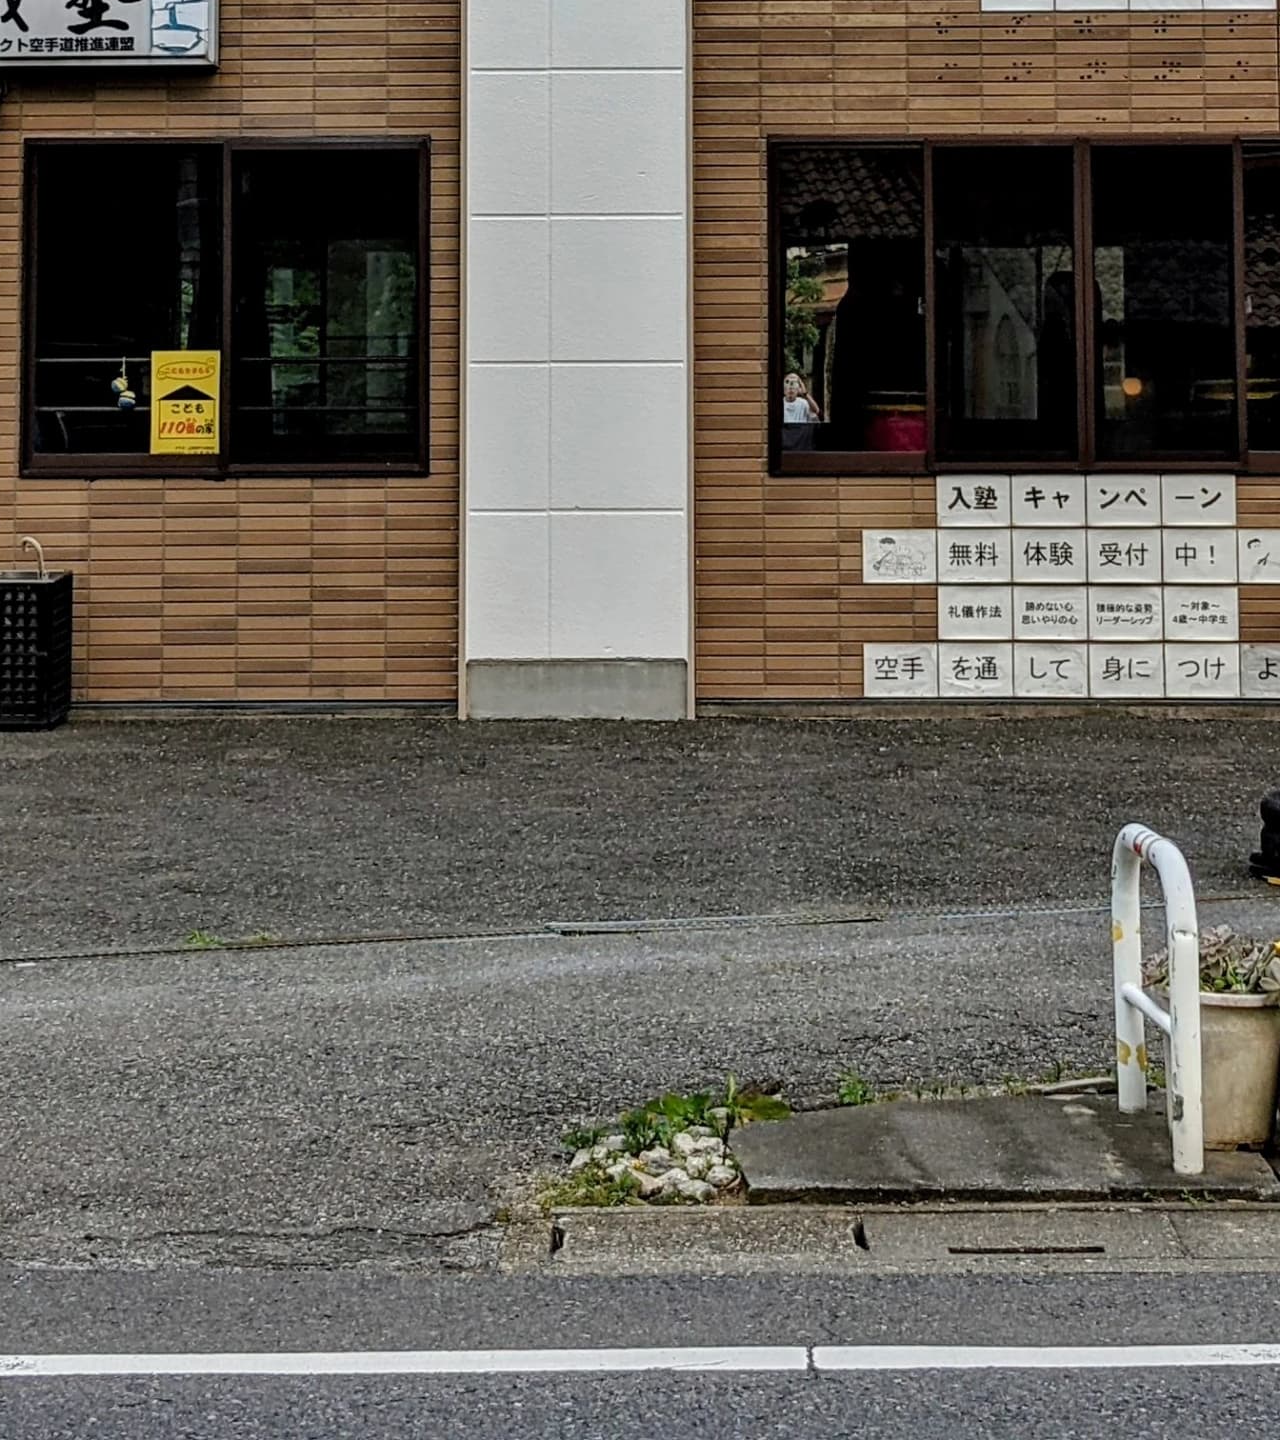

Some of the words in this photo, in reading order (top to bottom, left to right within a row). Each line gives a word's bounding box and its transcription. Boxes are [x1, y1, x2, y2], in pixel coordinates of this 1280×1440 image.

[171, 403, 205, 414] こども
[948, 486, 1222, 509] 入塾キャンペーン
[948, 605, 1002, 619] 礼儀作法
[1025, 602, 1074, 612] 諦めない心
[1021, 615, 1078, 625] 思いやりの心
[1096, 615, 1154, 625] リーダーシップ
